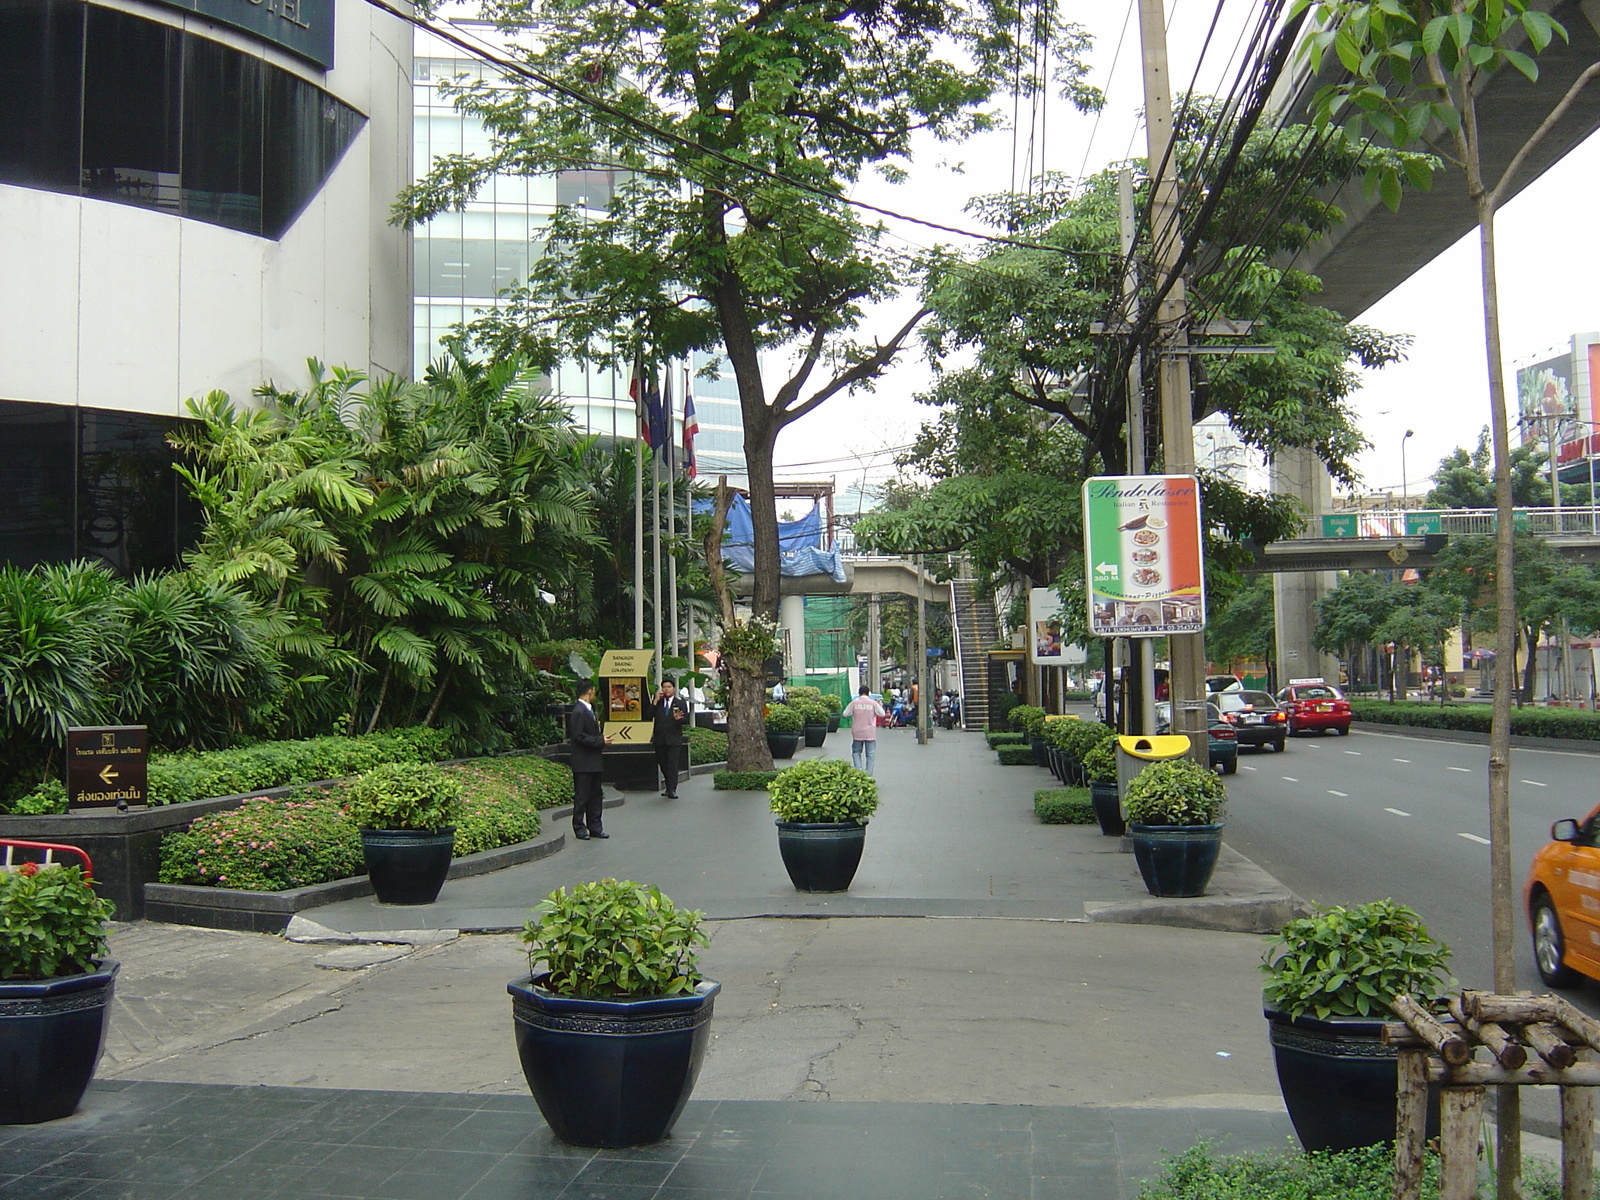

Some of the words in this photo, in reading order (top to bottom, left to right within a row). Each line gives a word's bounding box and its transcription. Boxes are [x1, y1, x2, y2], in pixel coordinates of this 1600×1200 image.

[77, 786, 140, 801] ส่งของเท่านั้น
